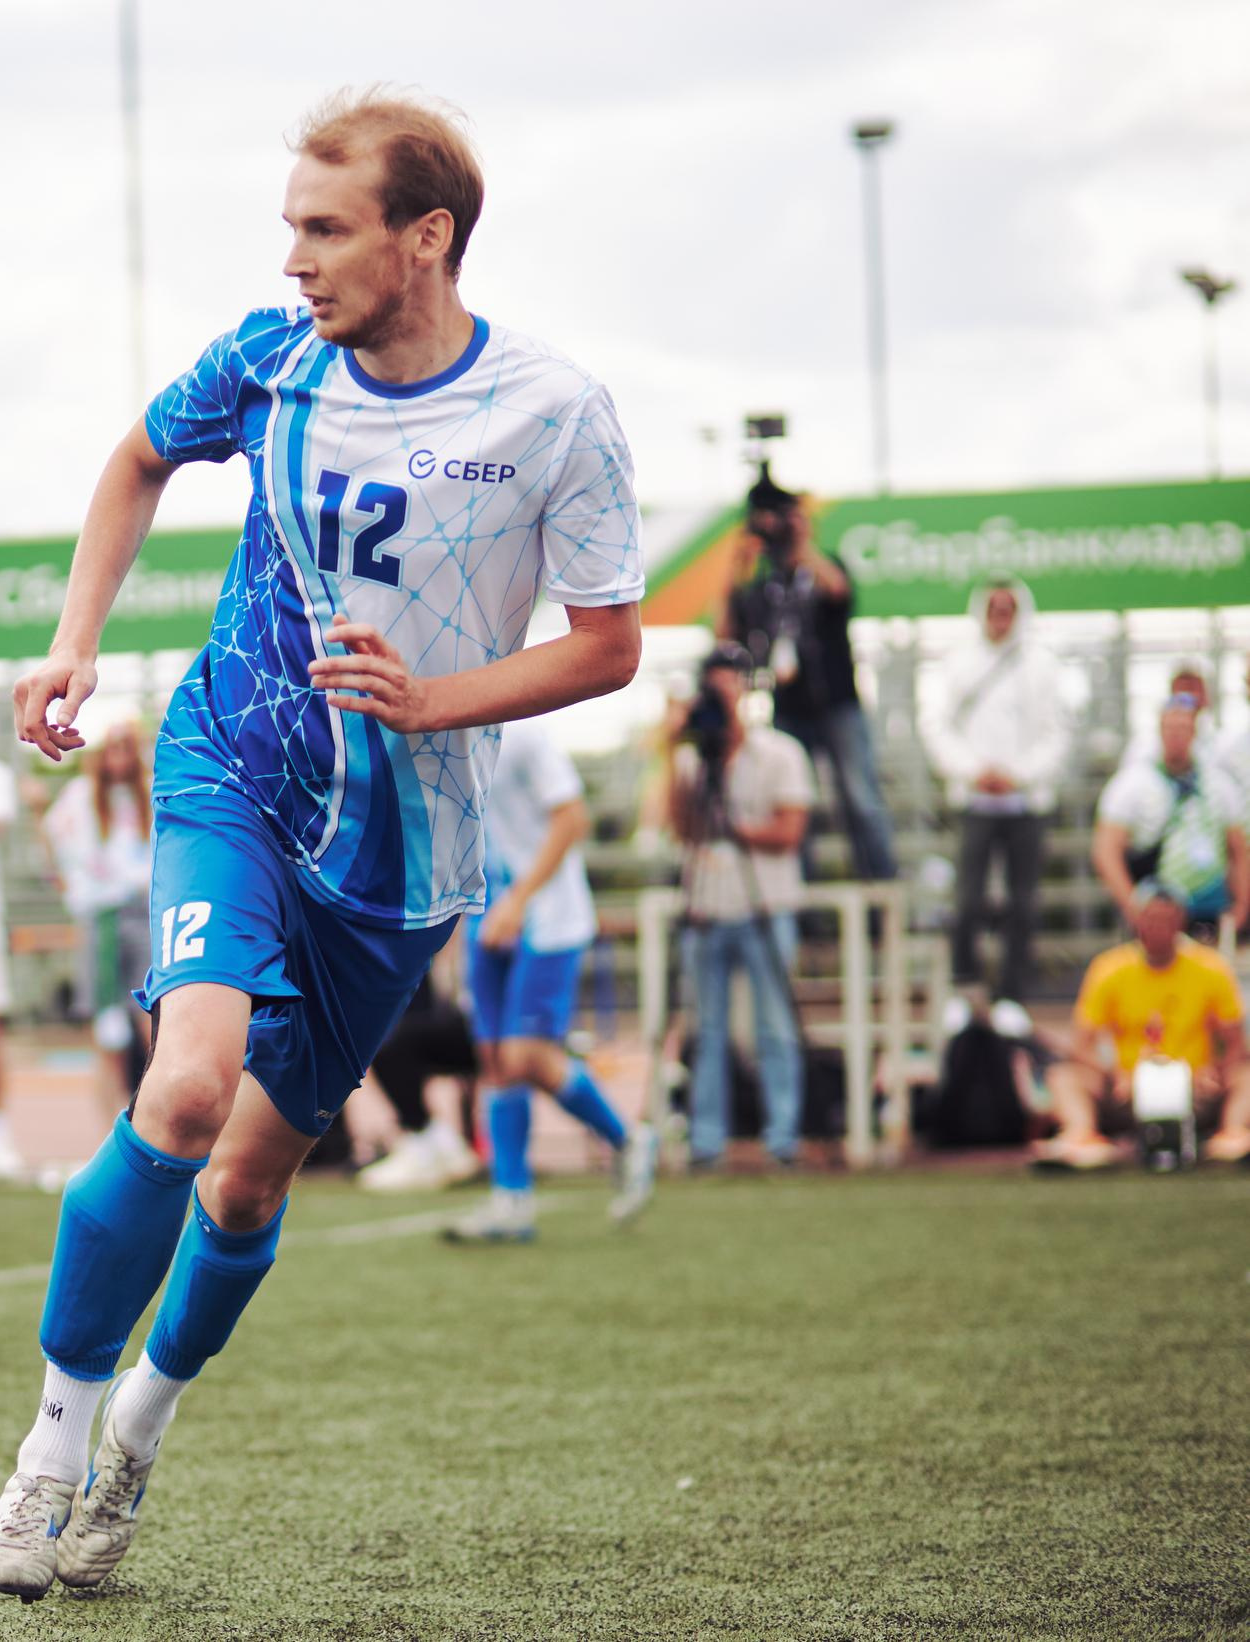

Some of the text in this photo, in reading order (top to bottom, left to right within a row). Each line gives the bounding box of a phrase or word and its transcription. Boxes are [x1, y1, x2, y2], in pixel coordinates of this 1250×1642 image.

[443, 459, 516, 483] СБЕР
[316, 467, 409, 589] 12
[161, 901, 212, 968] 12
